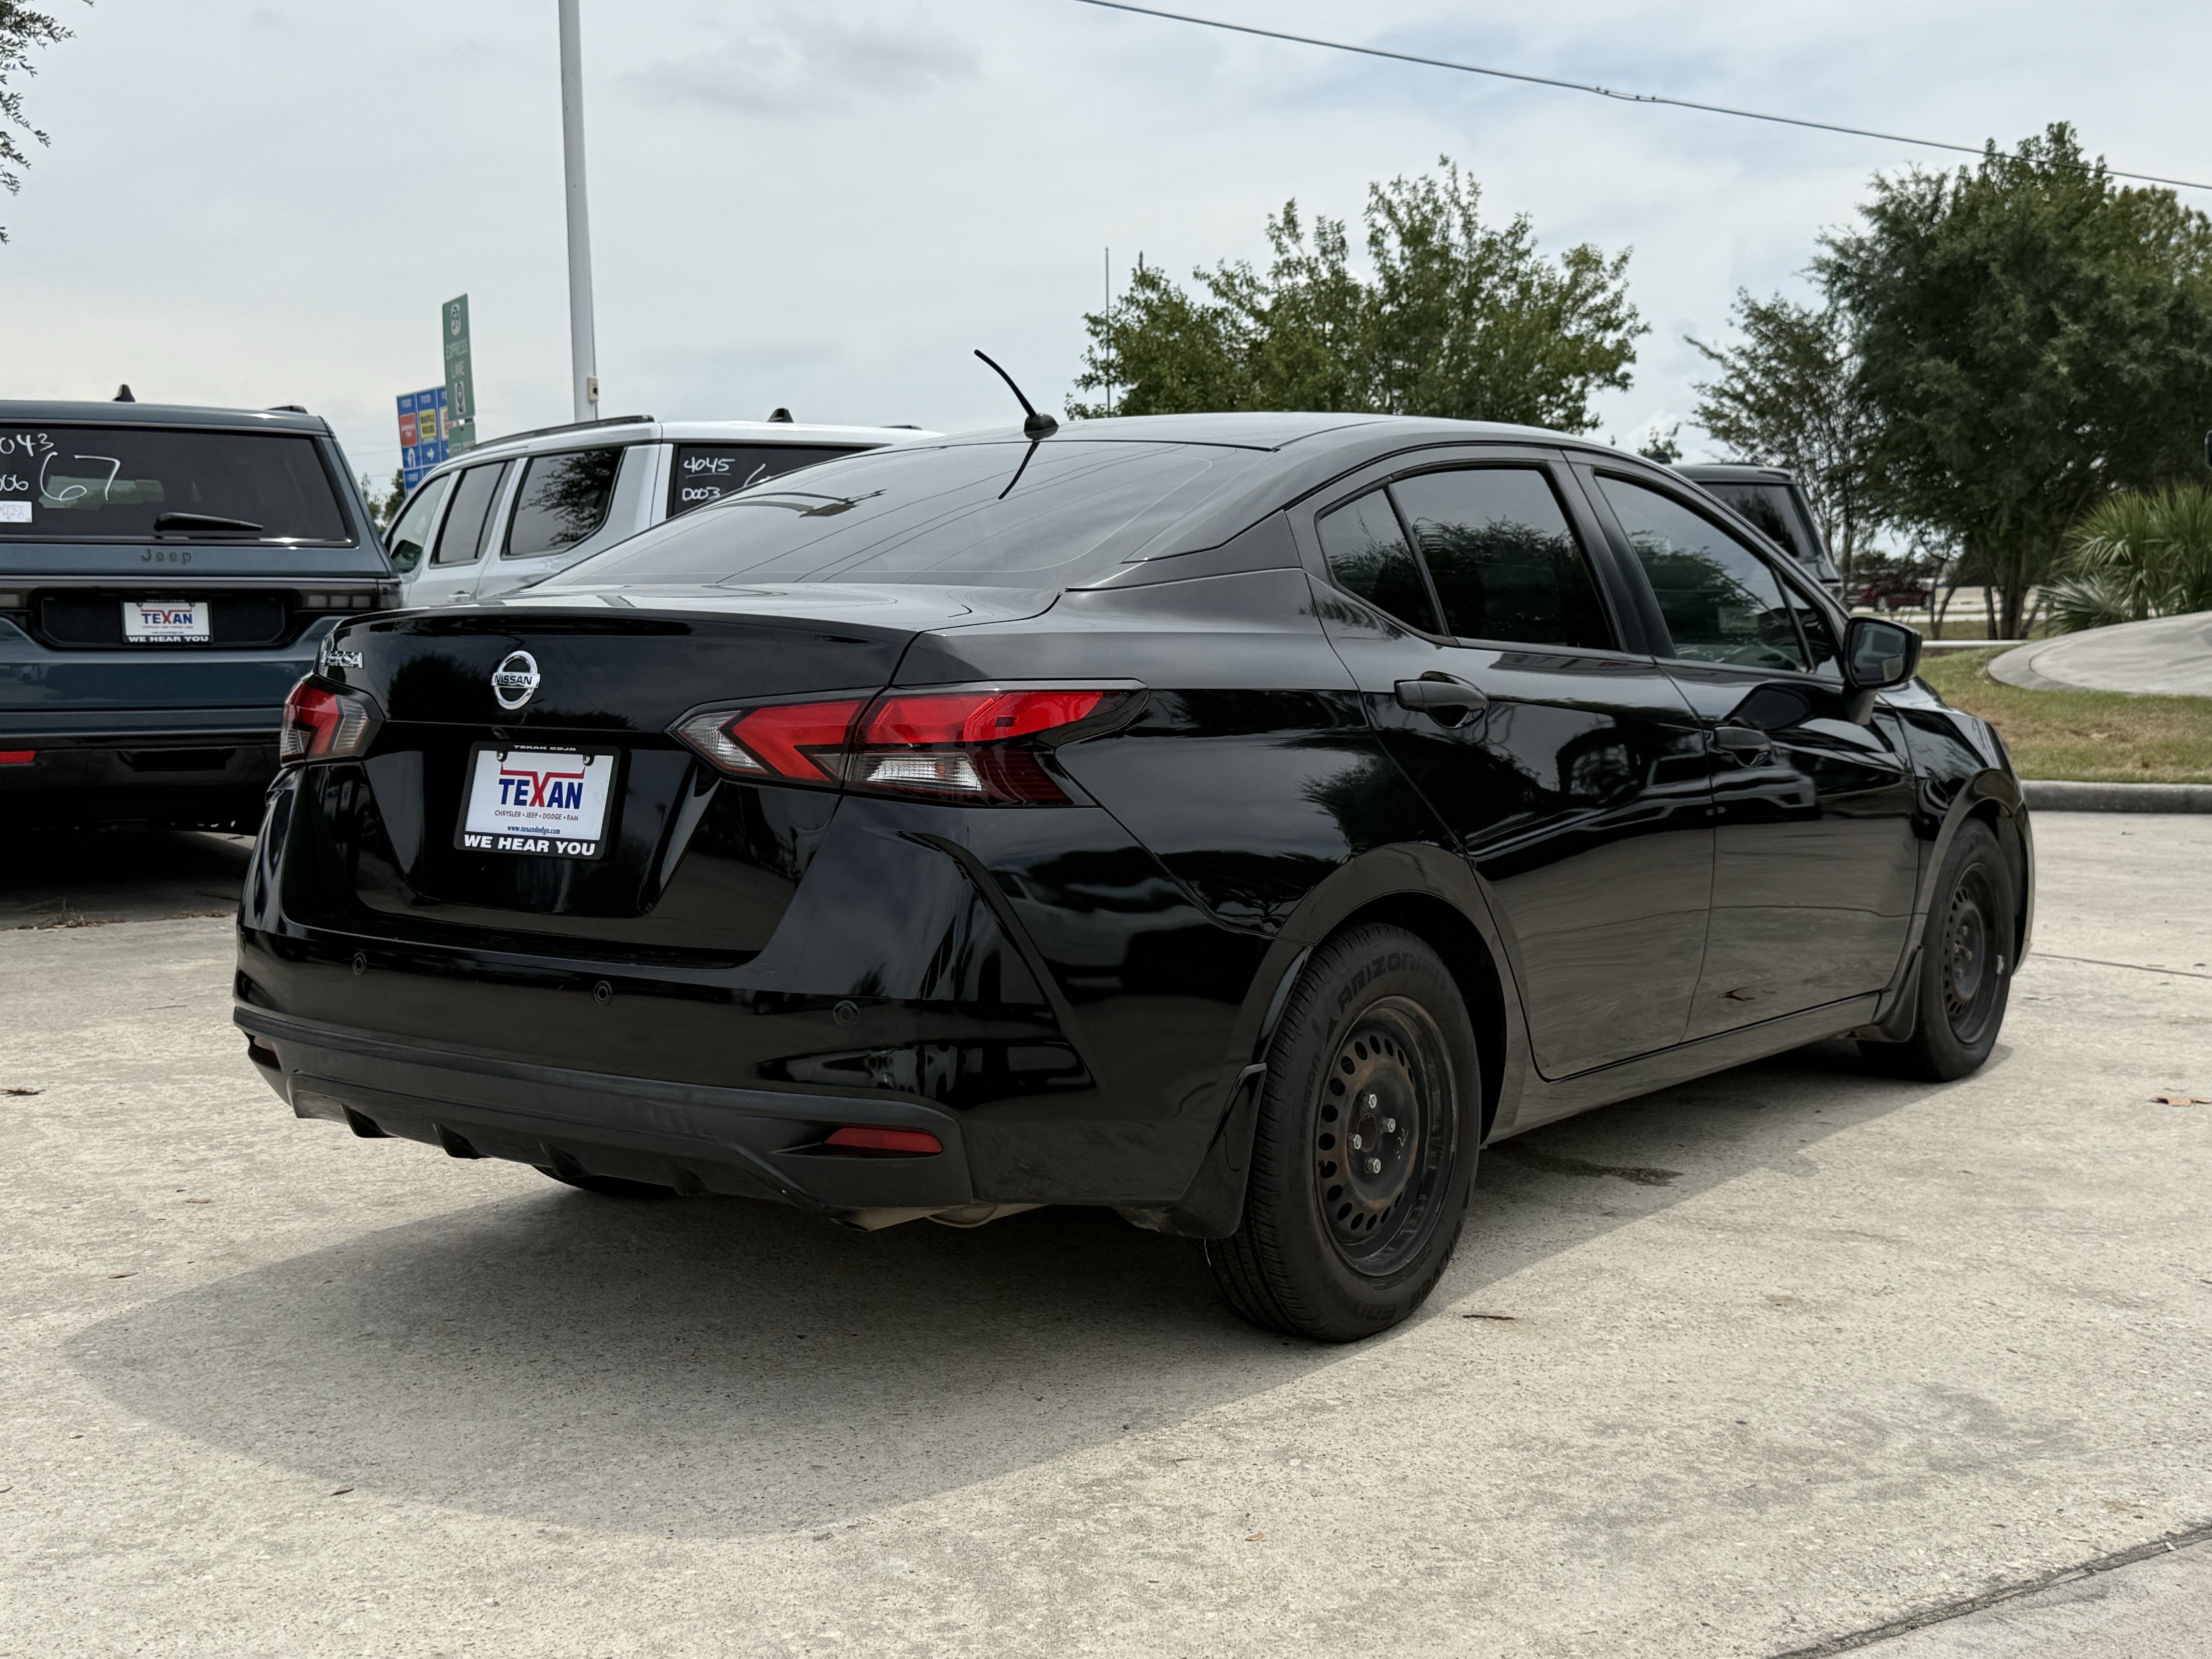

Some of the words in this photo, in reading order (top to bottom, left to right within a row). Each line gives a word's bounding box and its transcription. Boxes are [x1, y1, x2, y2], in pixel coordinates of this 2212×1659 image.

[446, 338, 468, 360] EXPRESS
[451, 360, 465, 378] LANE
[683, 457, 735, 473] 4045
[40, 452, 121, 501] 67
[141, 549, 192, 564] Jeep
[141, 610, 193, 624] TEXAN
[494, 675, 532, 685] NISSAN
[498, 770, 584, 809] TEXAN
[464, 835, 492, 848] WE
[498, 837, 549, 853] HEAR
[556, 841, 596, 856] YOU
